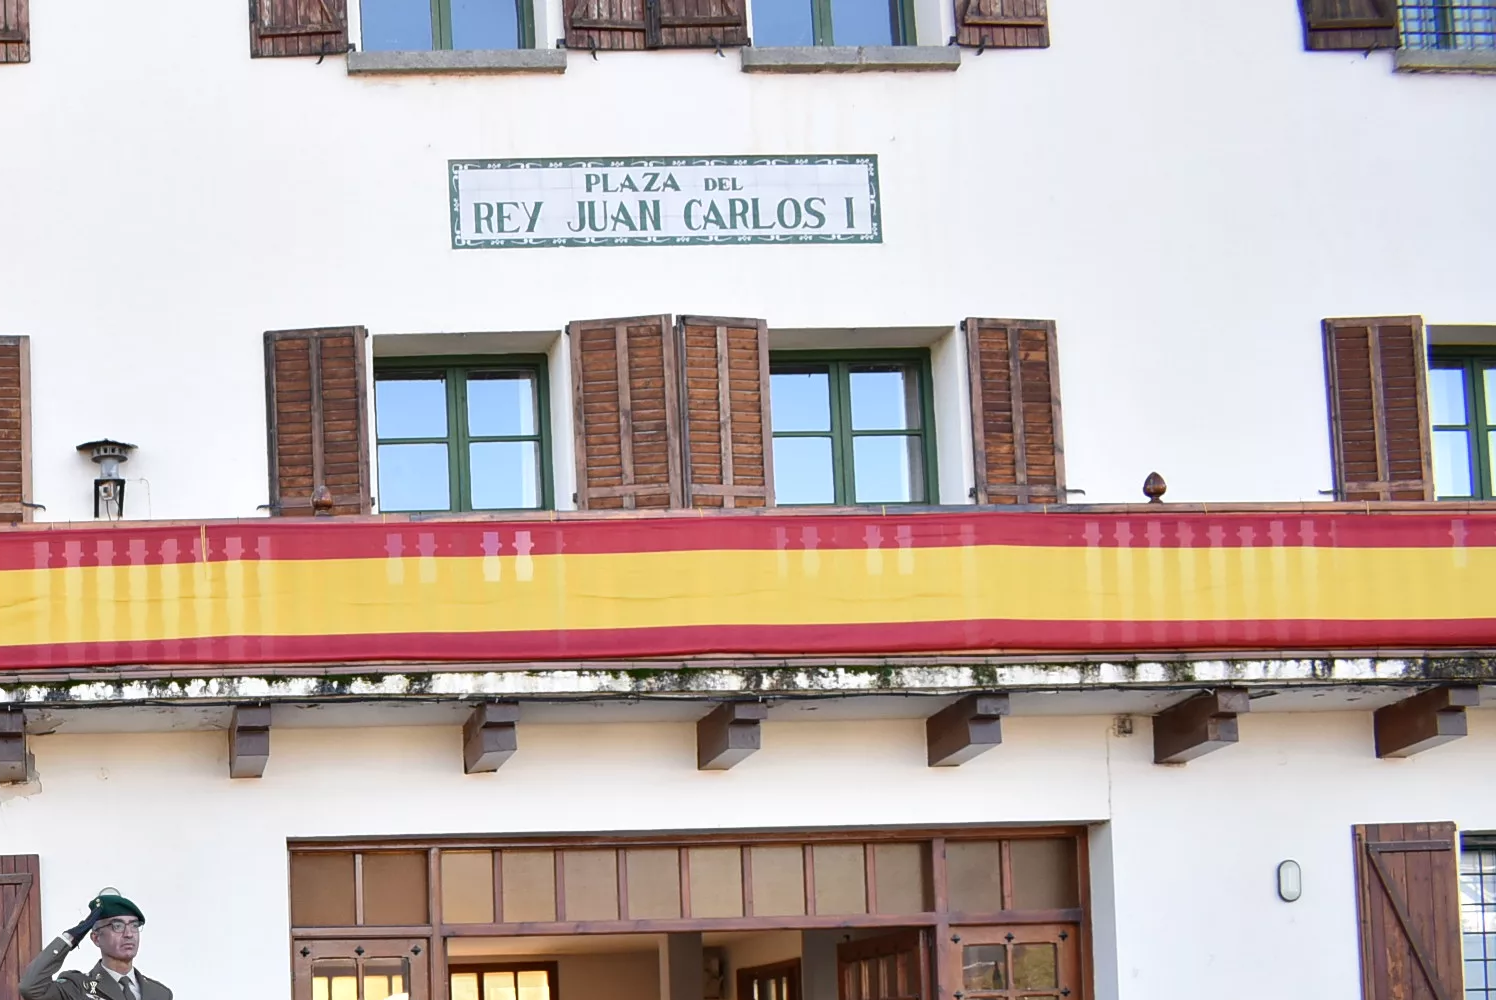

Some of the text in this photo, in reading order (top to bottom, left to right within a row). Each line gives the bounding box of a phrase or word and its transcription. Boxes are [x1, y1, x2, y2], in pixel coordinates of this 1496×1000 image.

[585, 172, 743, 193] PLAZA DEL
[473, 197, 855, 234] REY JUAN CARLOS I
